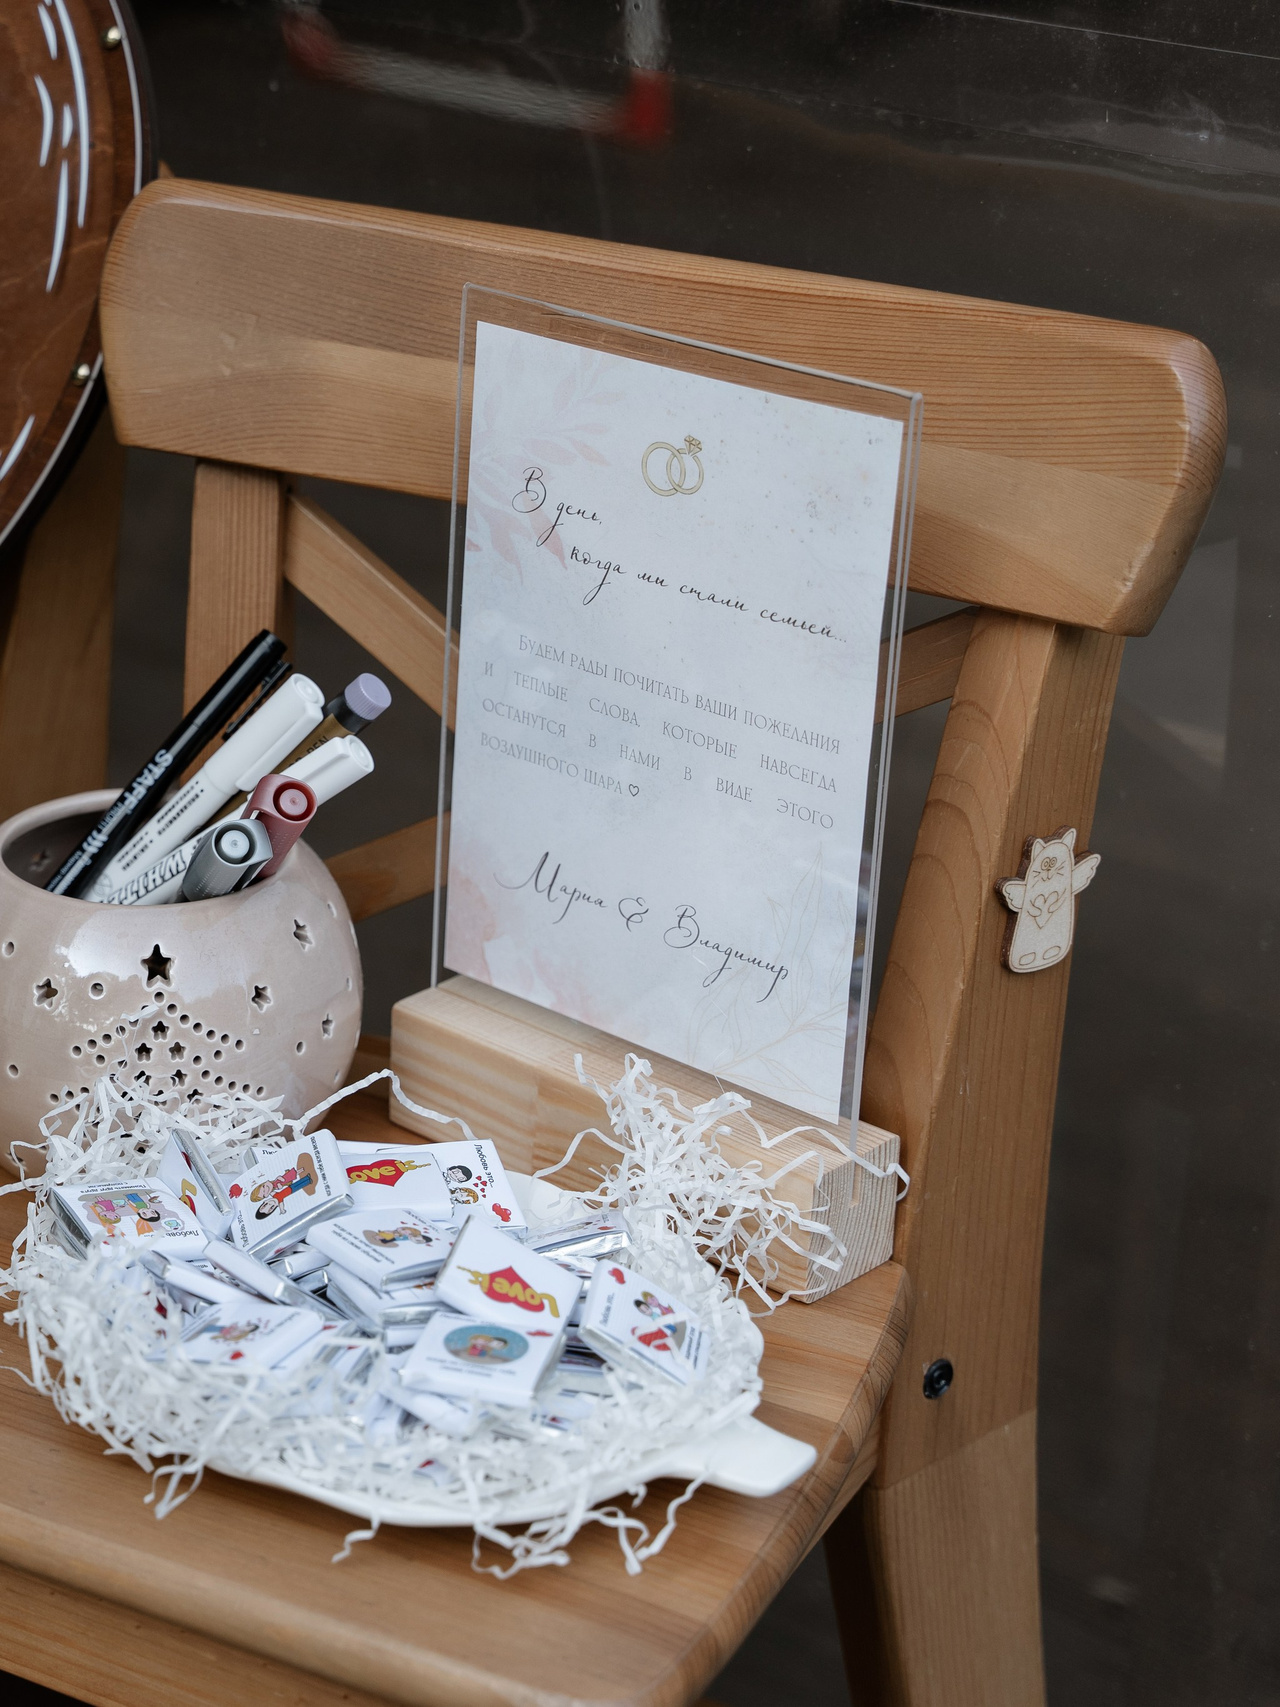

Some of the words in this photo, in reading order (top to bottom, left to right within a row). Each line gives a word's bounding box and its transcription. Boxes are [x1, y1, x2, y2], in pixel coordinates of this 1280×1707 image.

[512, 467, 547, 513] В
[536, 501, 602, 547] день,
[570, 545, 627, 606] когда
[679, 584, 749, 611] стали
[760, 607, 847, 643] семьей...
[484, 662, 493, 677] И
[514, 671, 568, 702] ТЕПЛЫЕ
[589, 698, 641, 728] СЛОВА,
[663, 722, 737, 759] КОТОРЫЕ
[760, 754, 837, 793] НАВСЕГДА
[519, 635, 565, 664] БУДЕМ
[570, 654, 608, 679] РАДЫ
[613, 668, 689, 704] ПОЧИТАТЬ
[696, 695, 737, 721] ВАШИ
[744, 710, 840, 754] ПОЖЕЛАНИЯ
[124, 749, 173, 811] STAFF
[480, 732, 578, 778] ВОЗДУШНОГО
[584, 767, 622, 795] ШАРА
[482, 698, 566, 738] ОСТАНУТСЯ
[588, 733, 597, 748] В
[619, 744, 661, 771] НАМИ
[684, 767, 692, 781] В
[716, 778, 752, 803] ВИДЕ
[777, 798, 834, 830] ЭТОГО
[618, 897, 650, 932] &
[663, 905, 789, 1003] Владимир
[474, 1144, 488, 1171] Любовь
[166, 1230, 199, 1238] Любовь
[492, 1277, 559, 1318] Love
